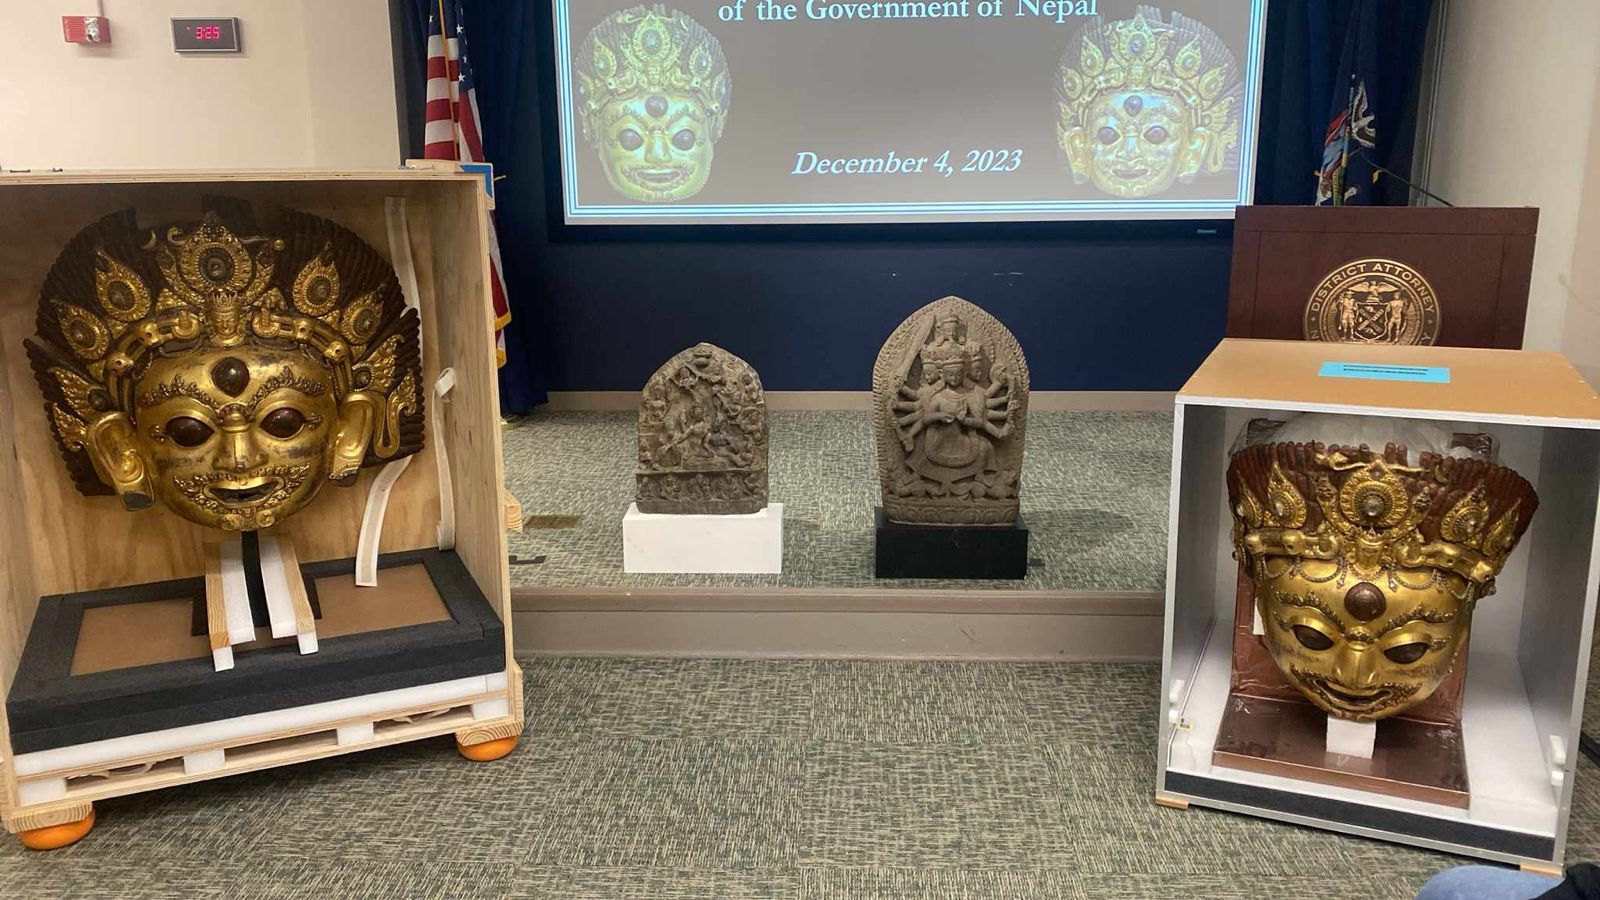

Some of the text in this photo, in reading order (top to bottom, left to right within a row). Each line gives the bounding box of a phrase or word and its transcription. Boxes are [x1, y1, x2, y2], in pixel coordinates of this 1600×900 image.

[718, 0, 1099, 24] of the Government of Nepal
[791, 149, 1024, 178] December 4, 2023
[1311, 263, 1435, 314] DISTRICT ATTORNEY
